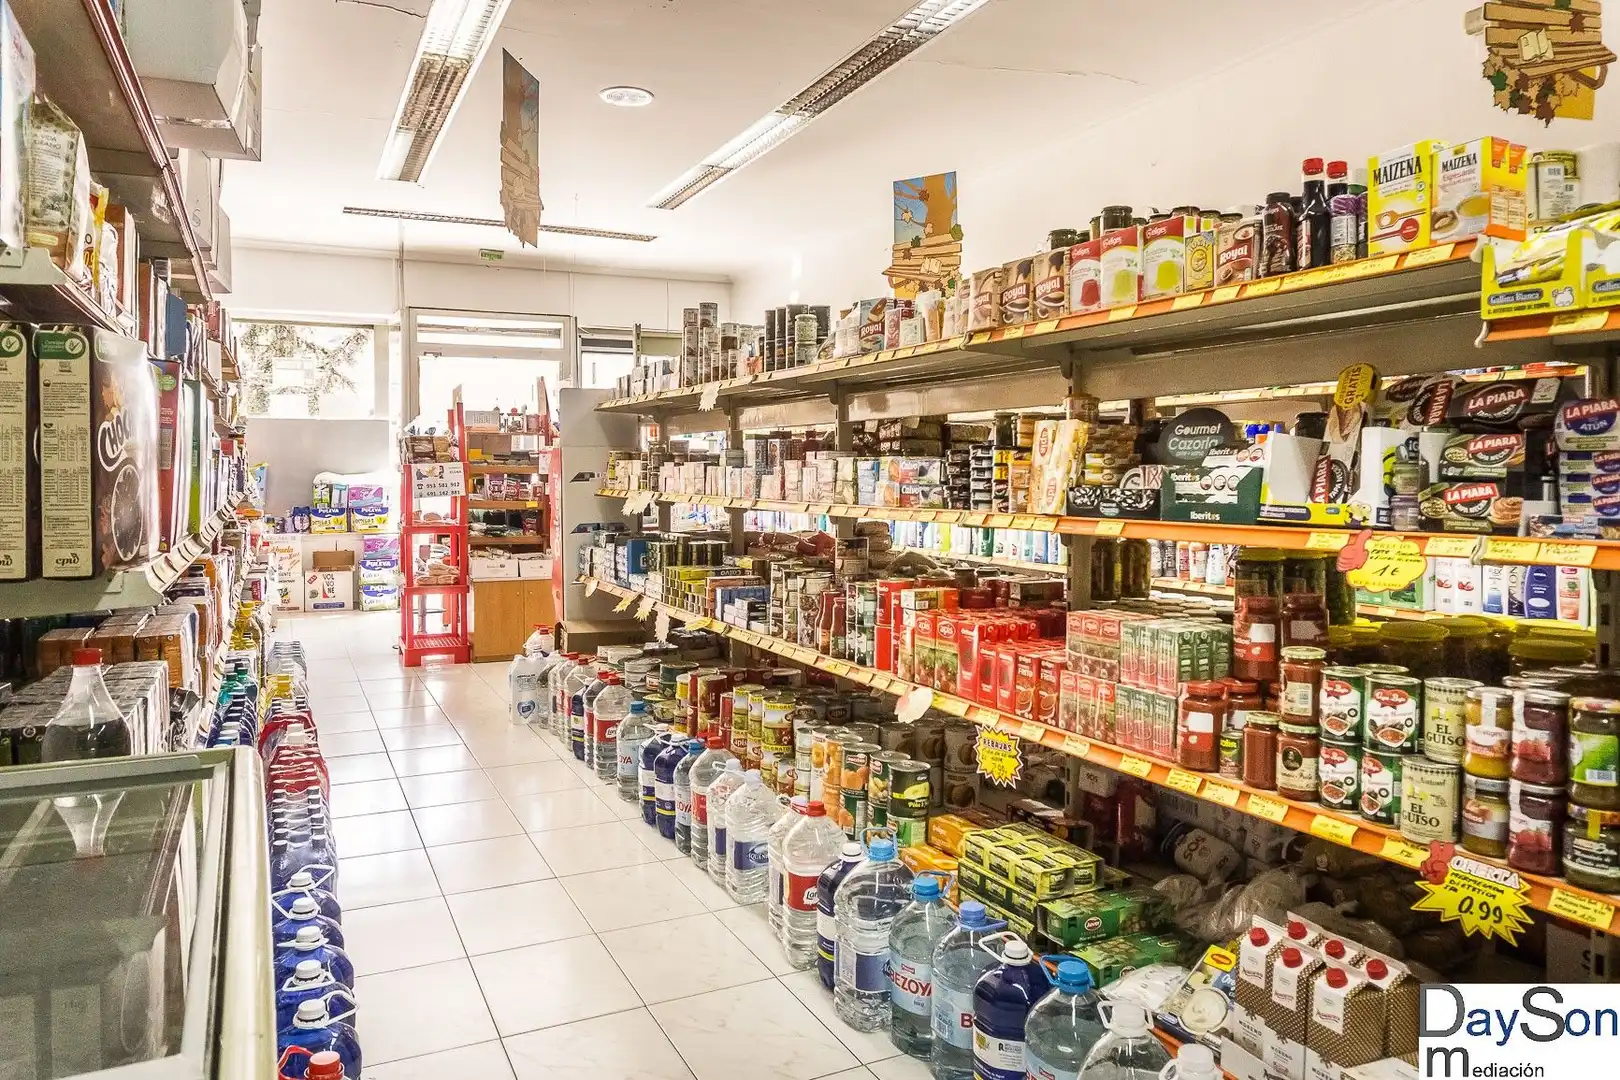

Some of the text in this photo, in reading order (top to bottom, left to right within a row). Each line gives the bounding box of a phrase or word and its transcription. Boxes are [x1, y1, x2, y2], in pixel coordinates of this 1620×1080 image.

[1442, 152, 1477, 173] MAIZENA
[1373, 156, 1422, 187] MAIZENA
[1219, 244, 1248, 265] Royal
[1002, 283, 1027, 301] Royal
[1035, 276, 1060, 296] Royal
[861, 322, 882, 337] Royal
[1344, 367, 1362, 404] GRATIS
[1468, 388, 1525, 409] LA PIARA
[1566, 399, 1619, 419] LA PIARA
[1174, 422, 1222, 435] Gourmet
[1168, 436, 1218, 450] Cazorla
[1470, 436, 1518, 452] LA PIARA
[1314, 459, 1329, 493] PIARA
[901, 484, 920, 495] Calvo
[1447, 485, 1494, 502] LA PIARA
[1190, 511, 1221, 521] Iberitos
[1018, 668, 1033, 678] FRITO
[1436, 723, 1452, 735] EL
[984, 738, 1012, 751] REBAJAS
[1426, 732, 1466, 747] GUISO
[1410, 802, 1426, 815] EL
[1402, 810, 1440, 828] GUISO
[1457, 895, 1503, 924] 0.99
[1270, 1046, 1294, 1061] MORENO
